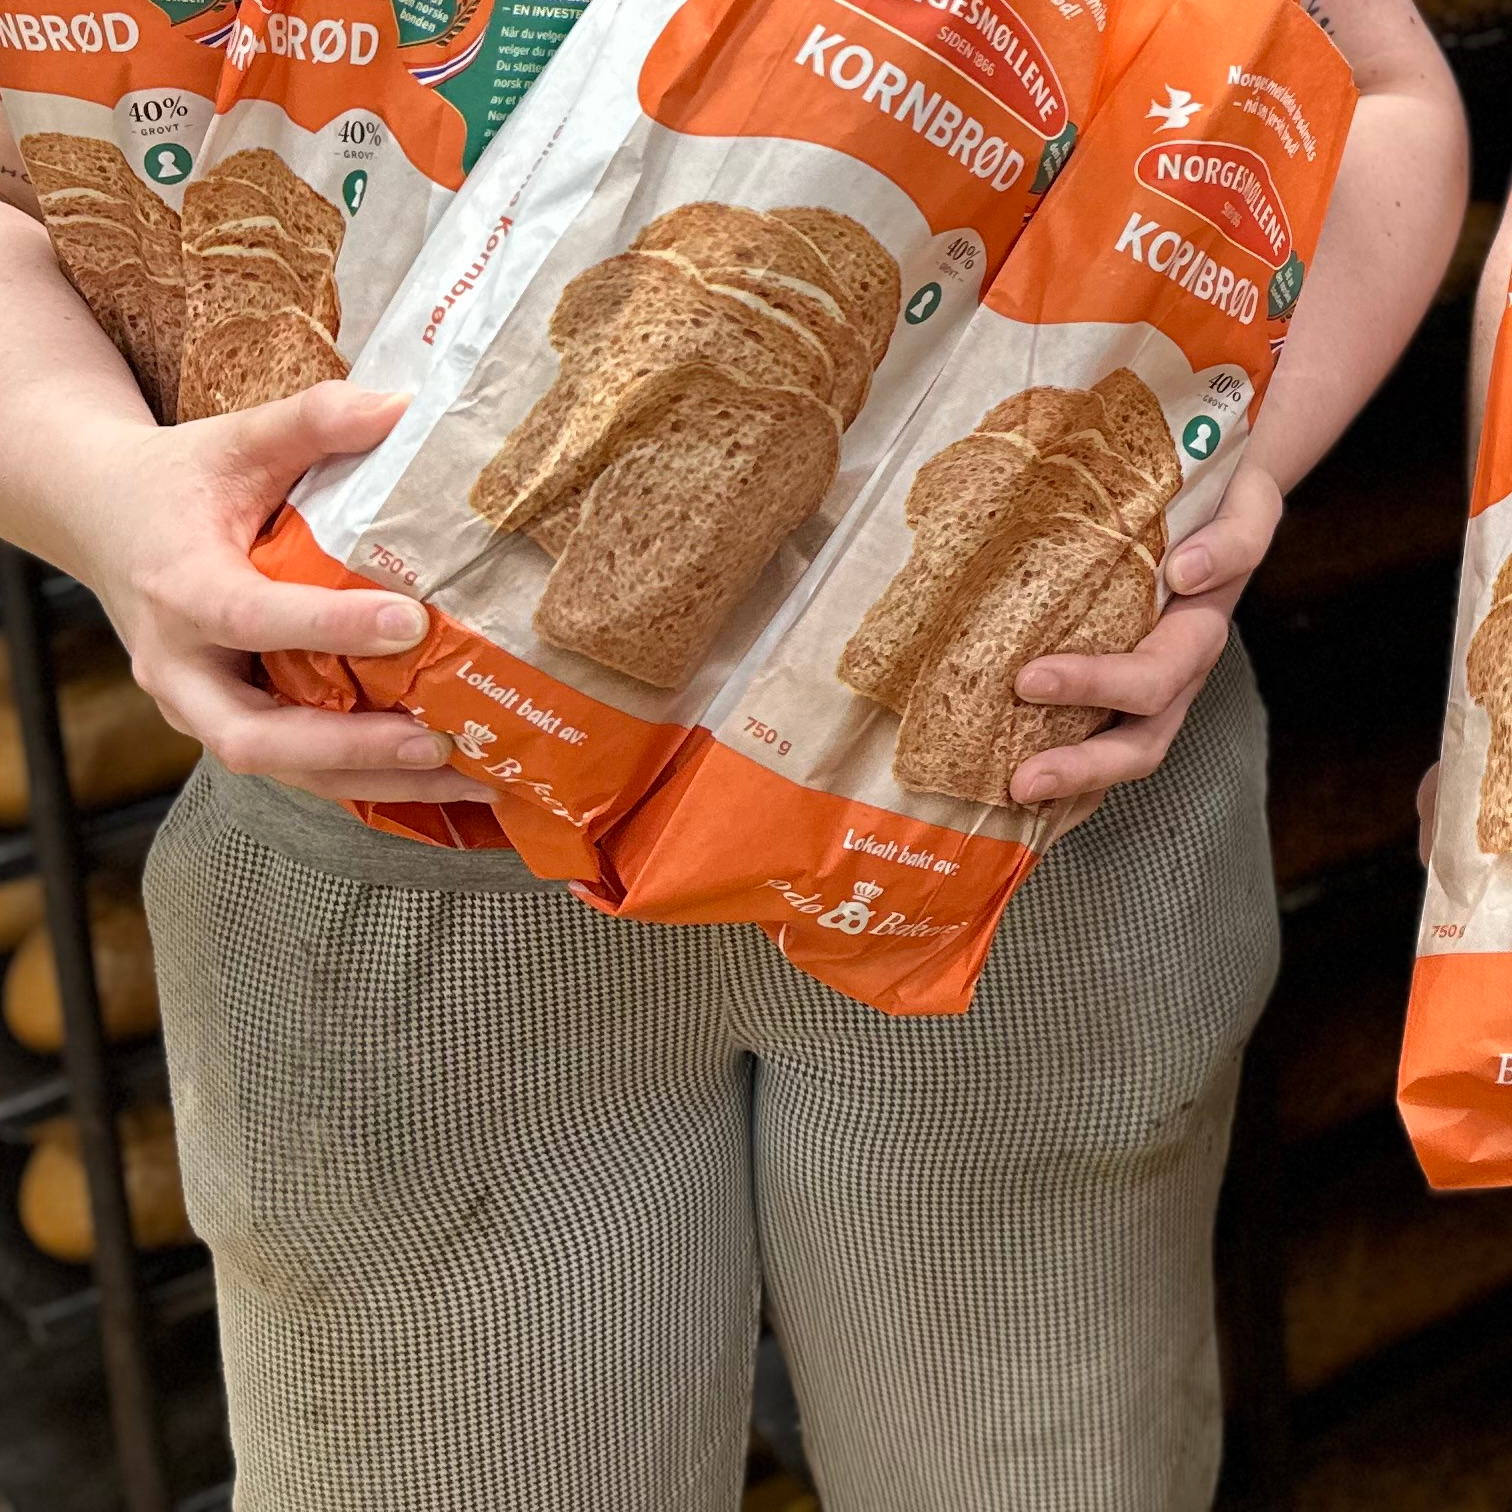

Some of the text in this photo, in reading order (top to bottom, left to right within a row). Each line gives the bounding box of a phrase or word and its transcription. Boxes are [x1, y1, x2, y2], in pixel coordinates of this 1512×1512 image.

[399, 9, 436, 32] bonden
[416, 1, 449, 24] norske
[937, 25, 996, 77] SIDEN 1866
[128, 96, 188, 123] 40%
[793, 24, 1025, 192] KORNBRØD
[140, 124, 180, 136] GROVT
[338, 120, 382, 147] 40%
[343, 150, 374, 160] GROVT
[946, 237, 981, 270] 40%
[1114, 211, 1260, 325] KORNBRØD
[422, 216, 513, 345] Kornbrød
[1208, 372, 1244, 402] 40%
[1202, 394, 1230, 413] GROVT
[370, 544, 420, 587] 750 g
[456, 660, 588, 747] Lokalt bakt av:
[743, 716, 793, 756] 750 g
[843, 828, 961, 876] Lokalt bakt av:
[1430, 924, 1466, 941] 750 g
